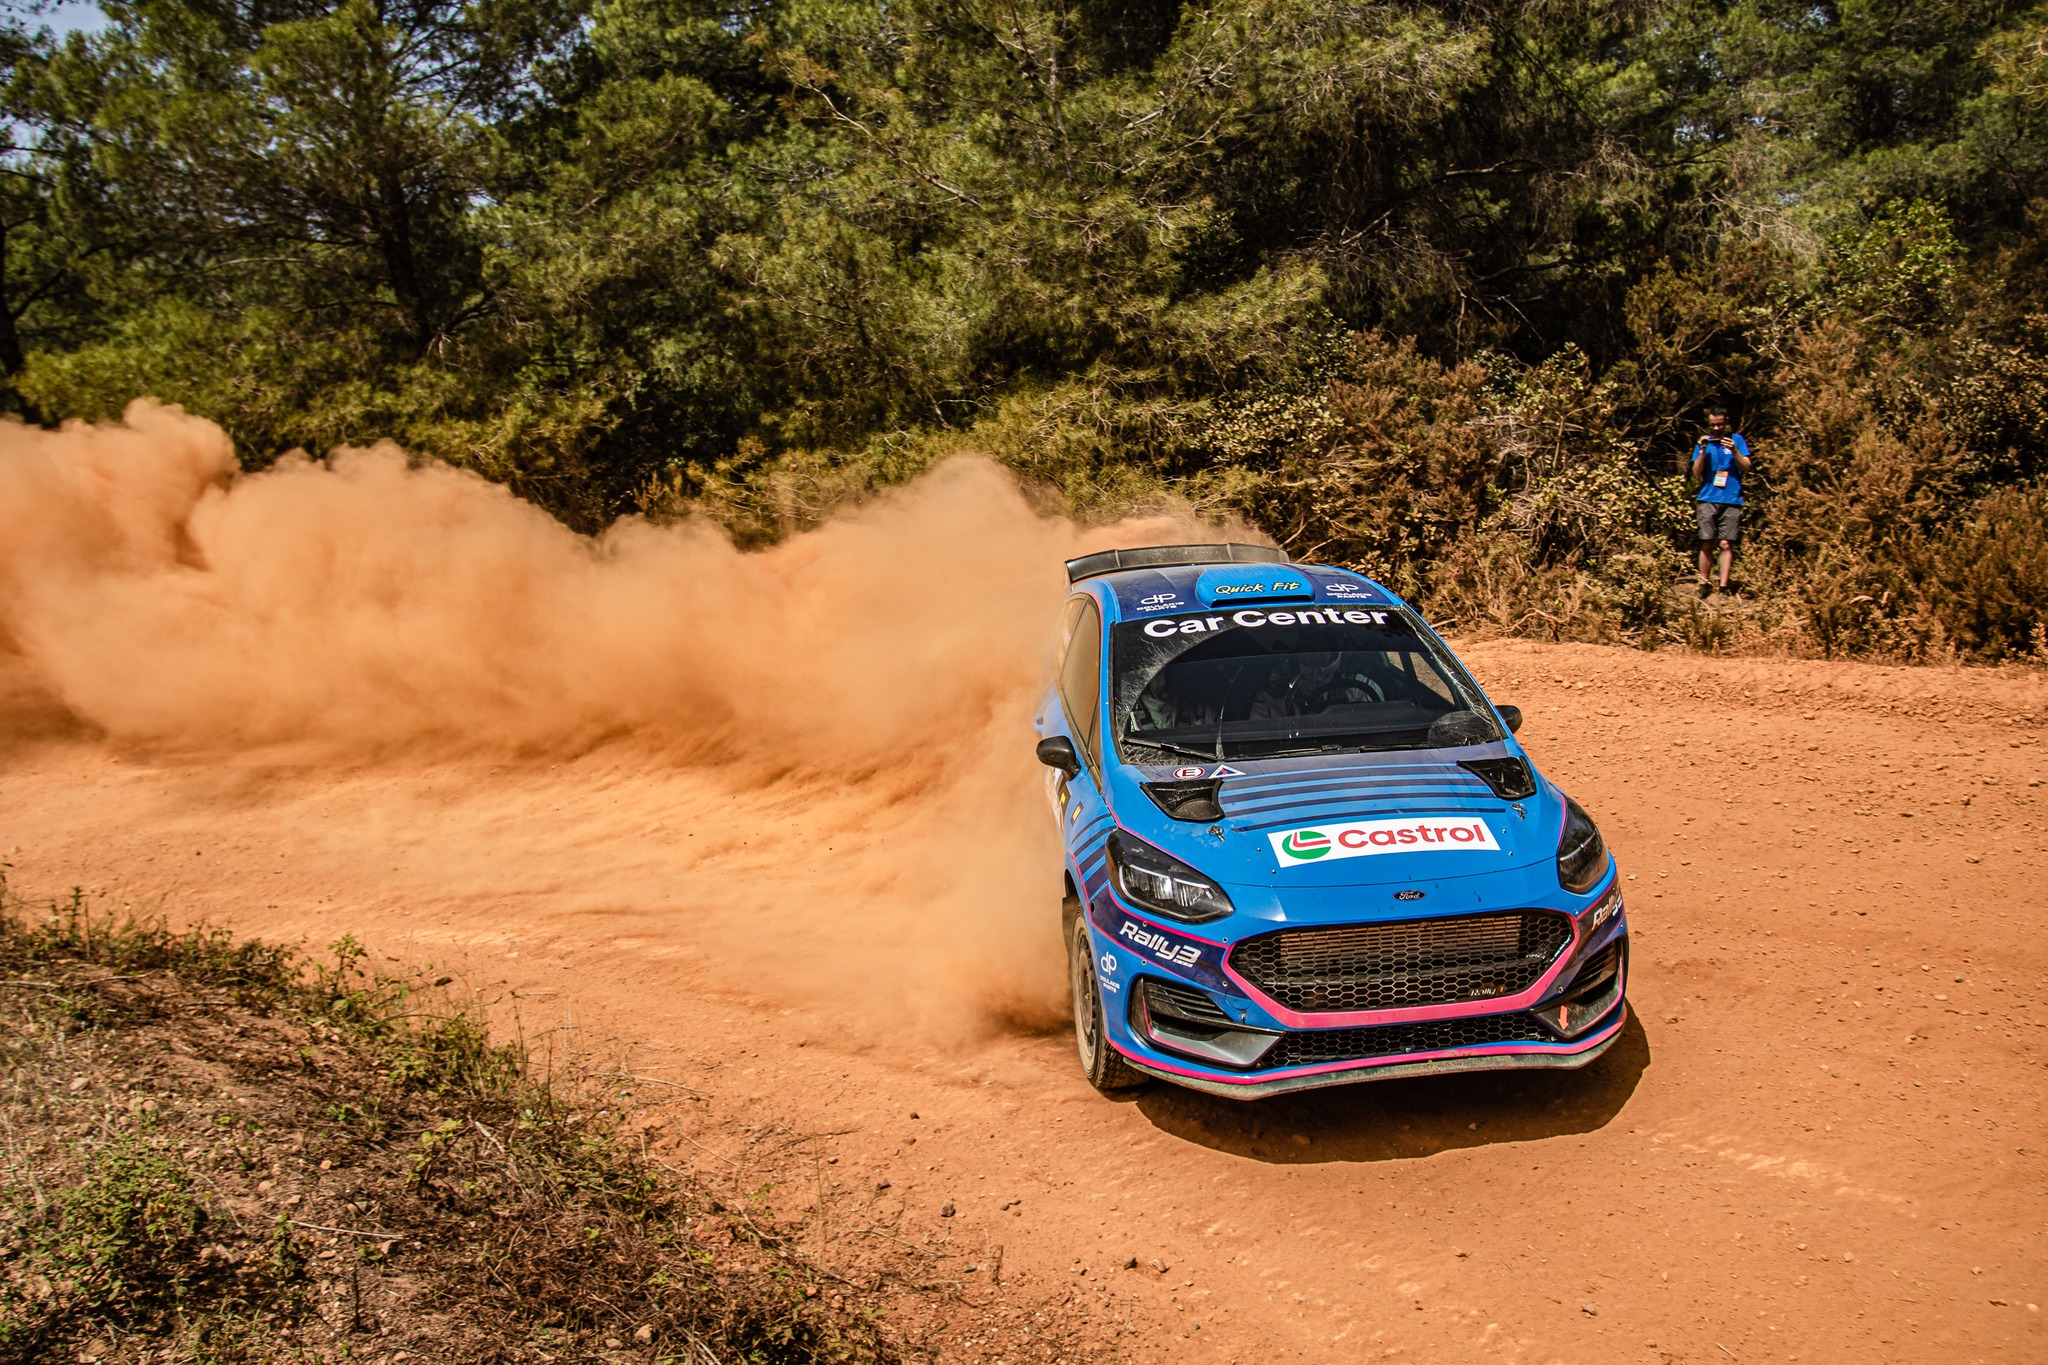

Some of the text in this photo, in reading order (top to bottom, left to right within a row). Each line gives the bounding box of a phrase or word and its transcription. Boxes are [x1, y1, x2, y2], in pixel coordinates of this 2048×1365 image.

[1214, 581, 1301, 595] Quick Fit
[1144, 608, 1388, 638] Car Center
[1182, 768, 1196, 777] E
[1338, 824, 1486, 849] Castrol
[1399, 891, 1420, 900] Ford
[1119, 920, 1202, 964] Rally3
